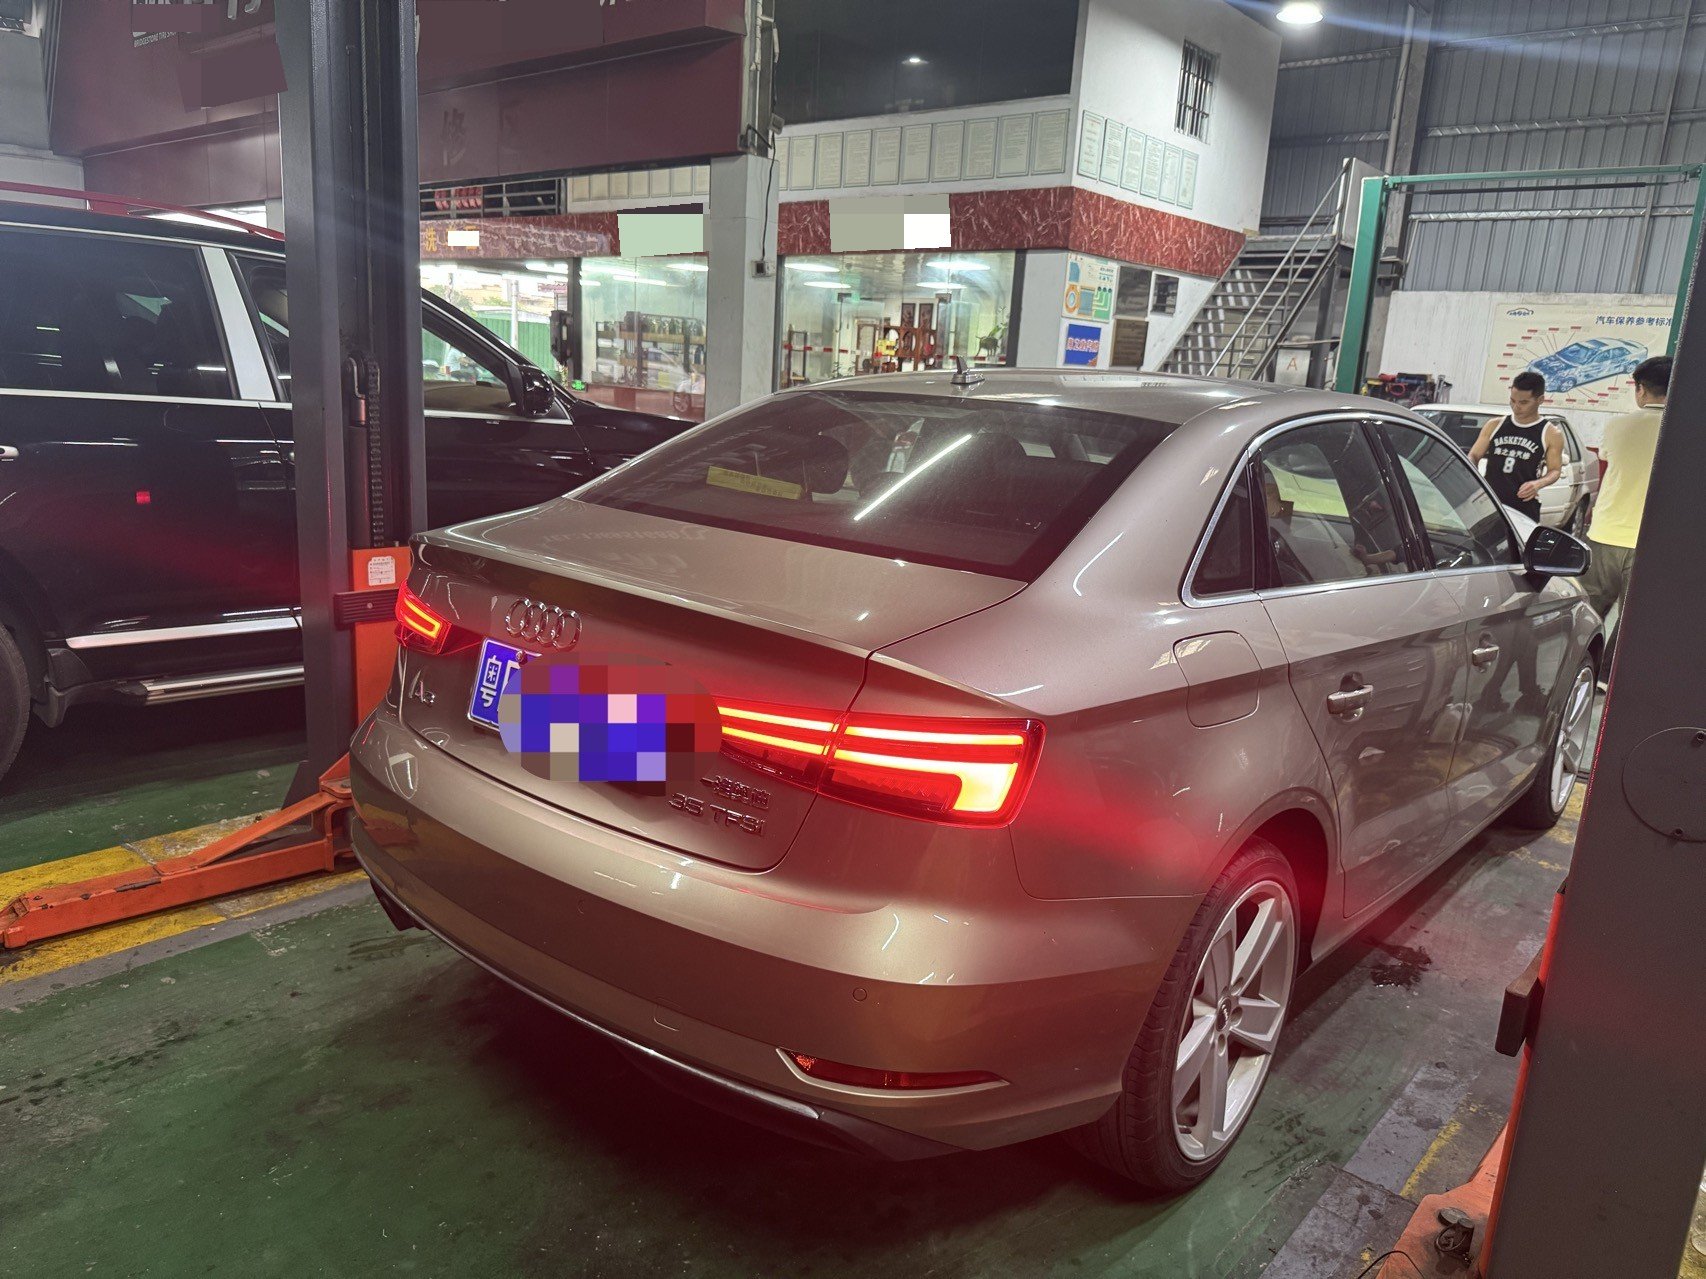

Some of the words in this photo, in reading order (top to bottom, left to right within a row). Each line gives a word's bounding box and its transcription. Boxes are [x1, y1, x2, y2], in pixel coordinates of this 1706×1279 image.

[1494, 436, 1539, 453] BASKETBALL
[1503, 457, 1515, 473] 8
[669, 793, 704, 816] 35
[710, 804, 765, 836] TFSI
